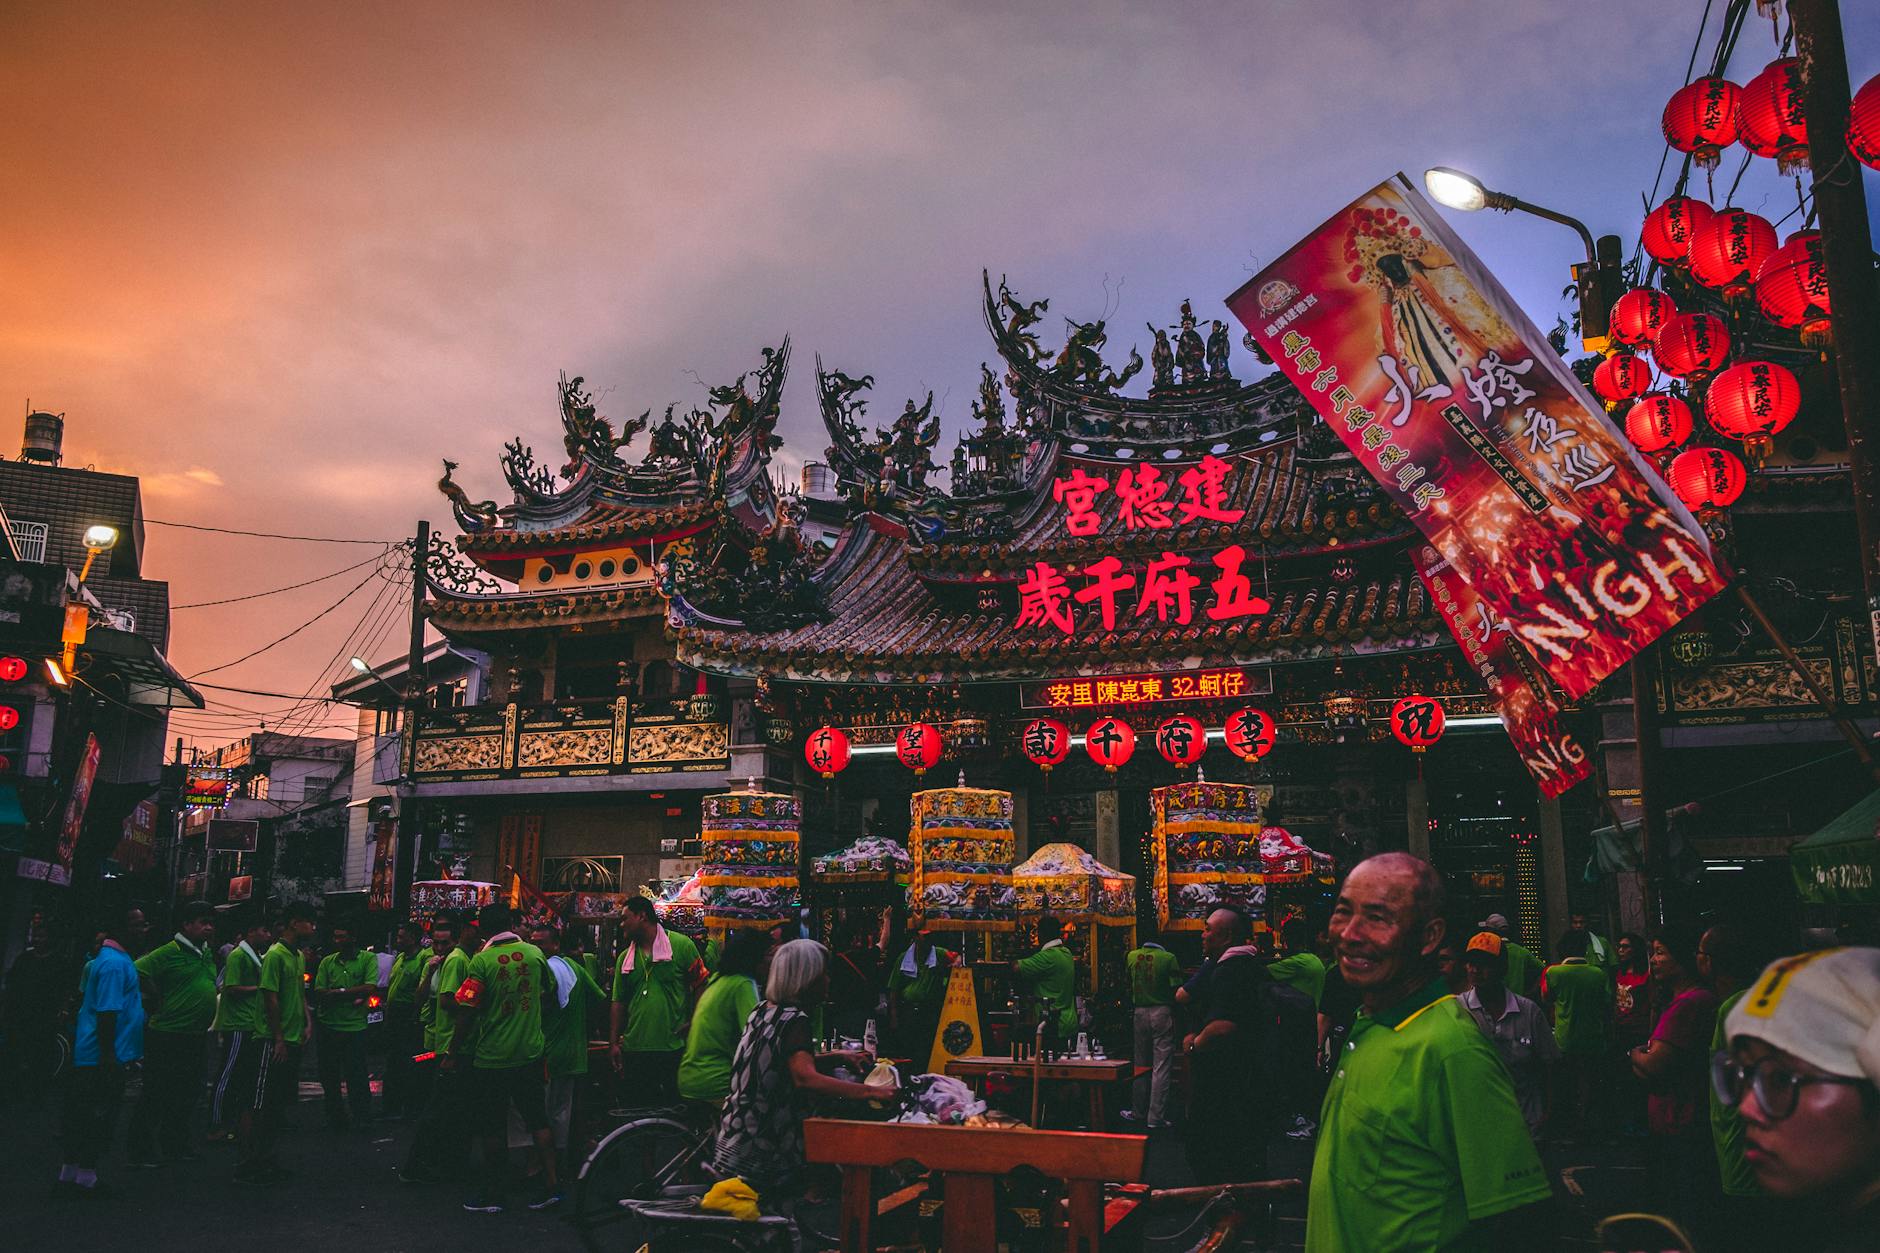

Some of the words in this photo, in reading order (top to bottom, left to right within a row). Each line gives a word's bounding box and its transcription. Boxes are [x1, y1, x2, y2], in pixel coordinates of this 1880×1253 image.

[1159, 719, 1192, 758] 府
[1231, 711, 1269, 754] 李
[1399, 700, 1441, 740] 祝
[1091, 721, 1123, 759] 千
